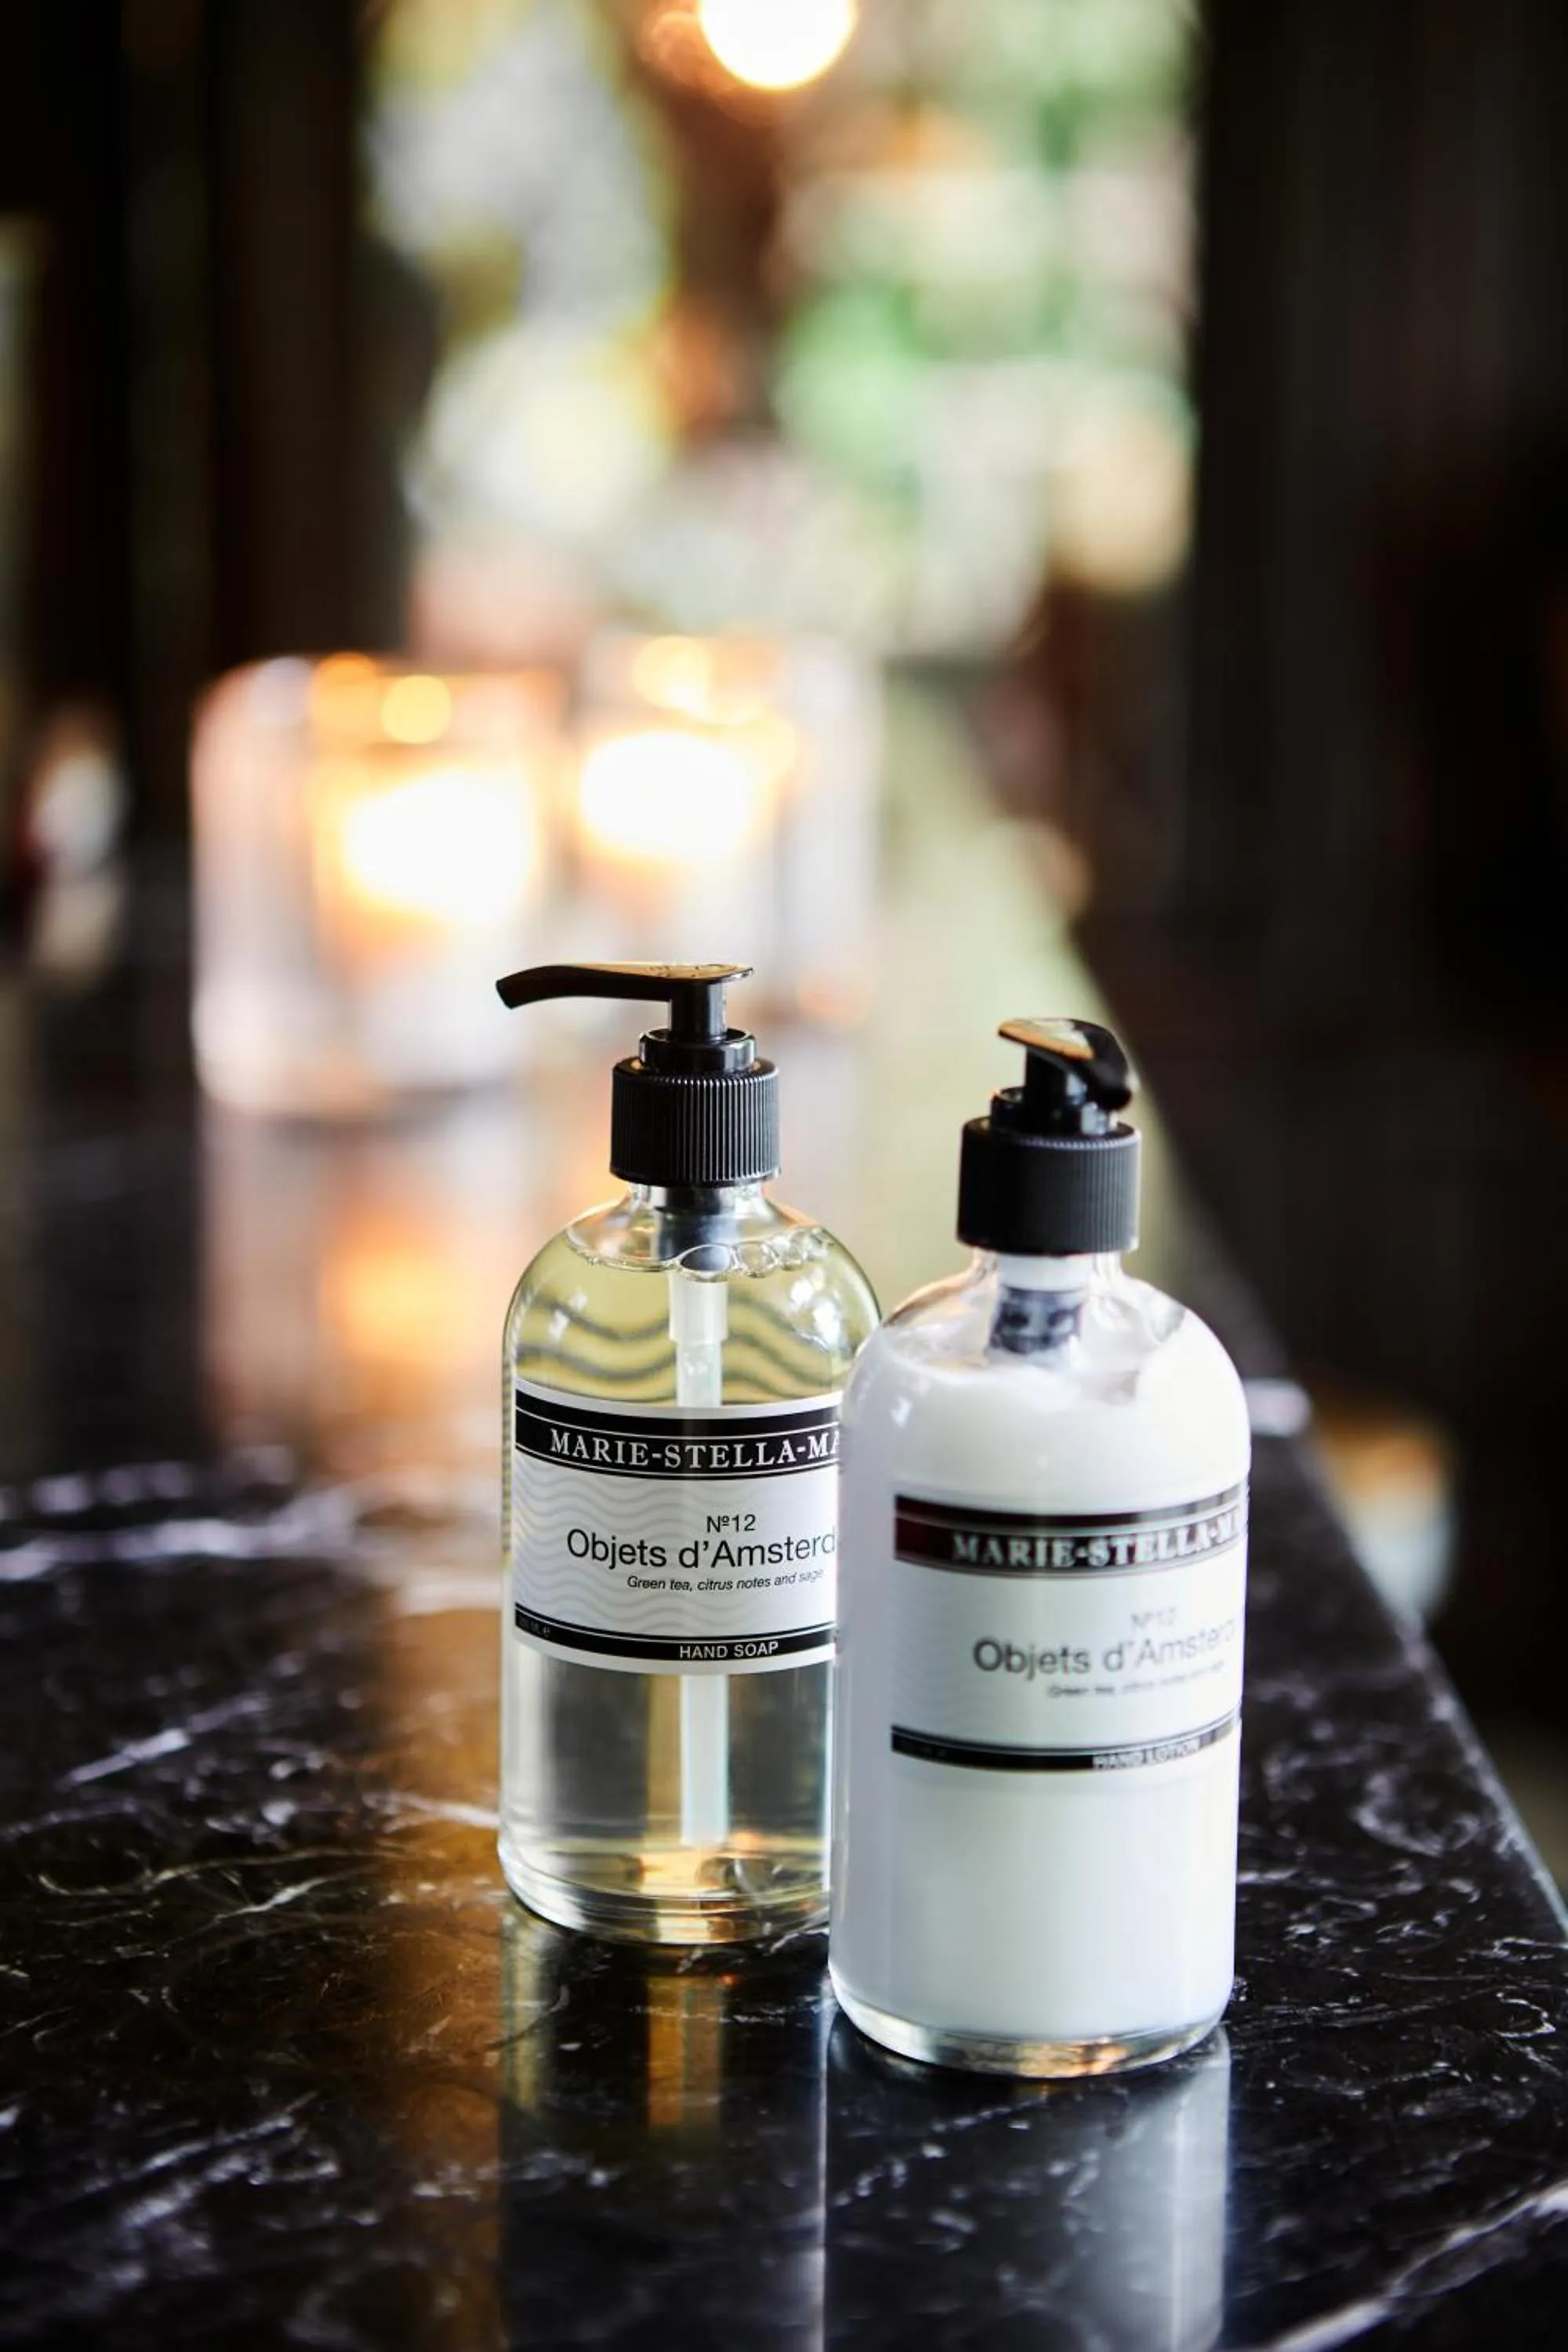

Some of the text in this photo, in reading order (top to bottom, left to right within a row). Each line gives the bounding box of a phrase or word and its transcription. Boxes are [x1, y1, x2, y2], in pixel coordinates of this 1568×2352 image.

[567, 1528, 667, 1570] Objets
[627, 1575, 666, 1590] Green
[670, 1577, 693, 1592] tea,
[698, 1575, 733, 1591] citrus
[737, 1575, 771, 1590] notes
[775, 1571, 797, 1586] and
[679, 1641, 779, 1659] HAND SOAP
[972, 1635, 1091, 1681] Objets
